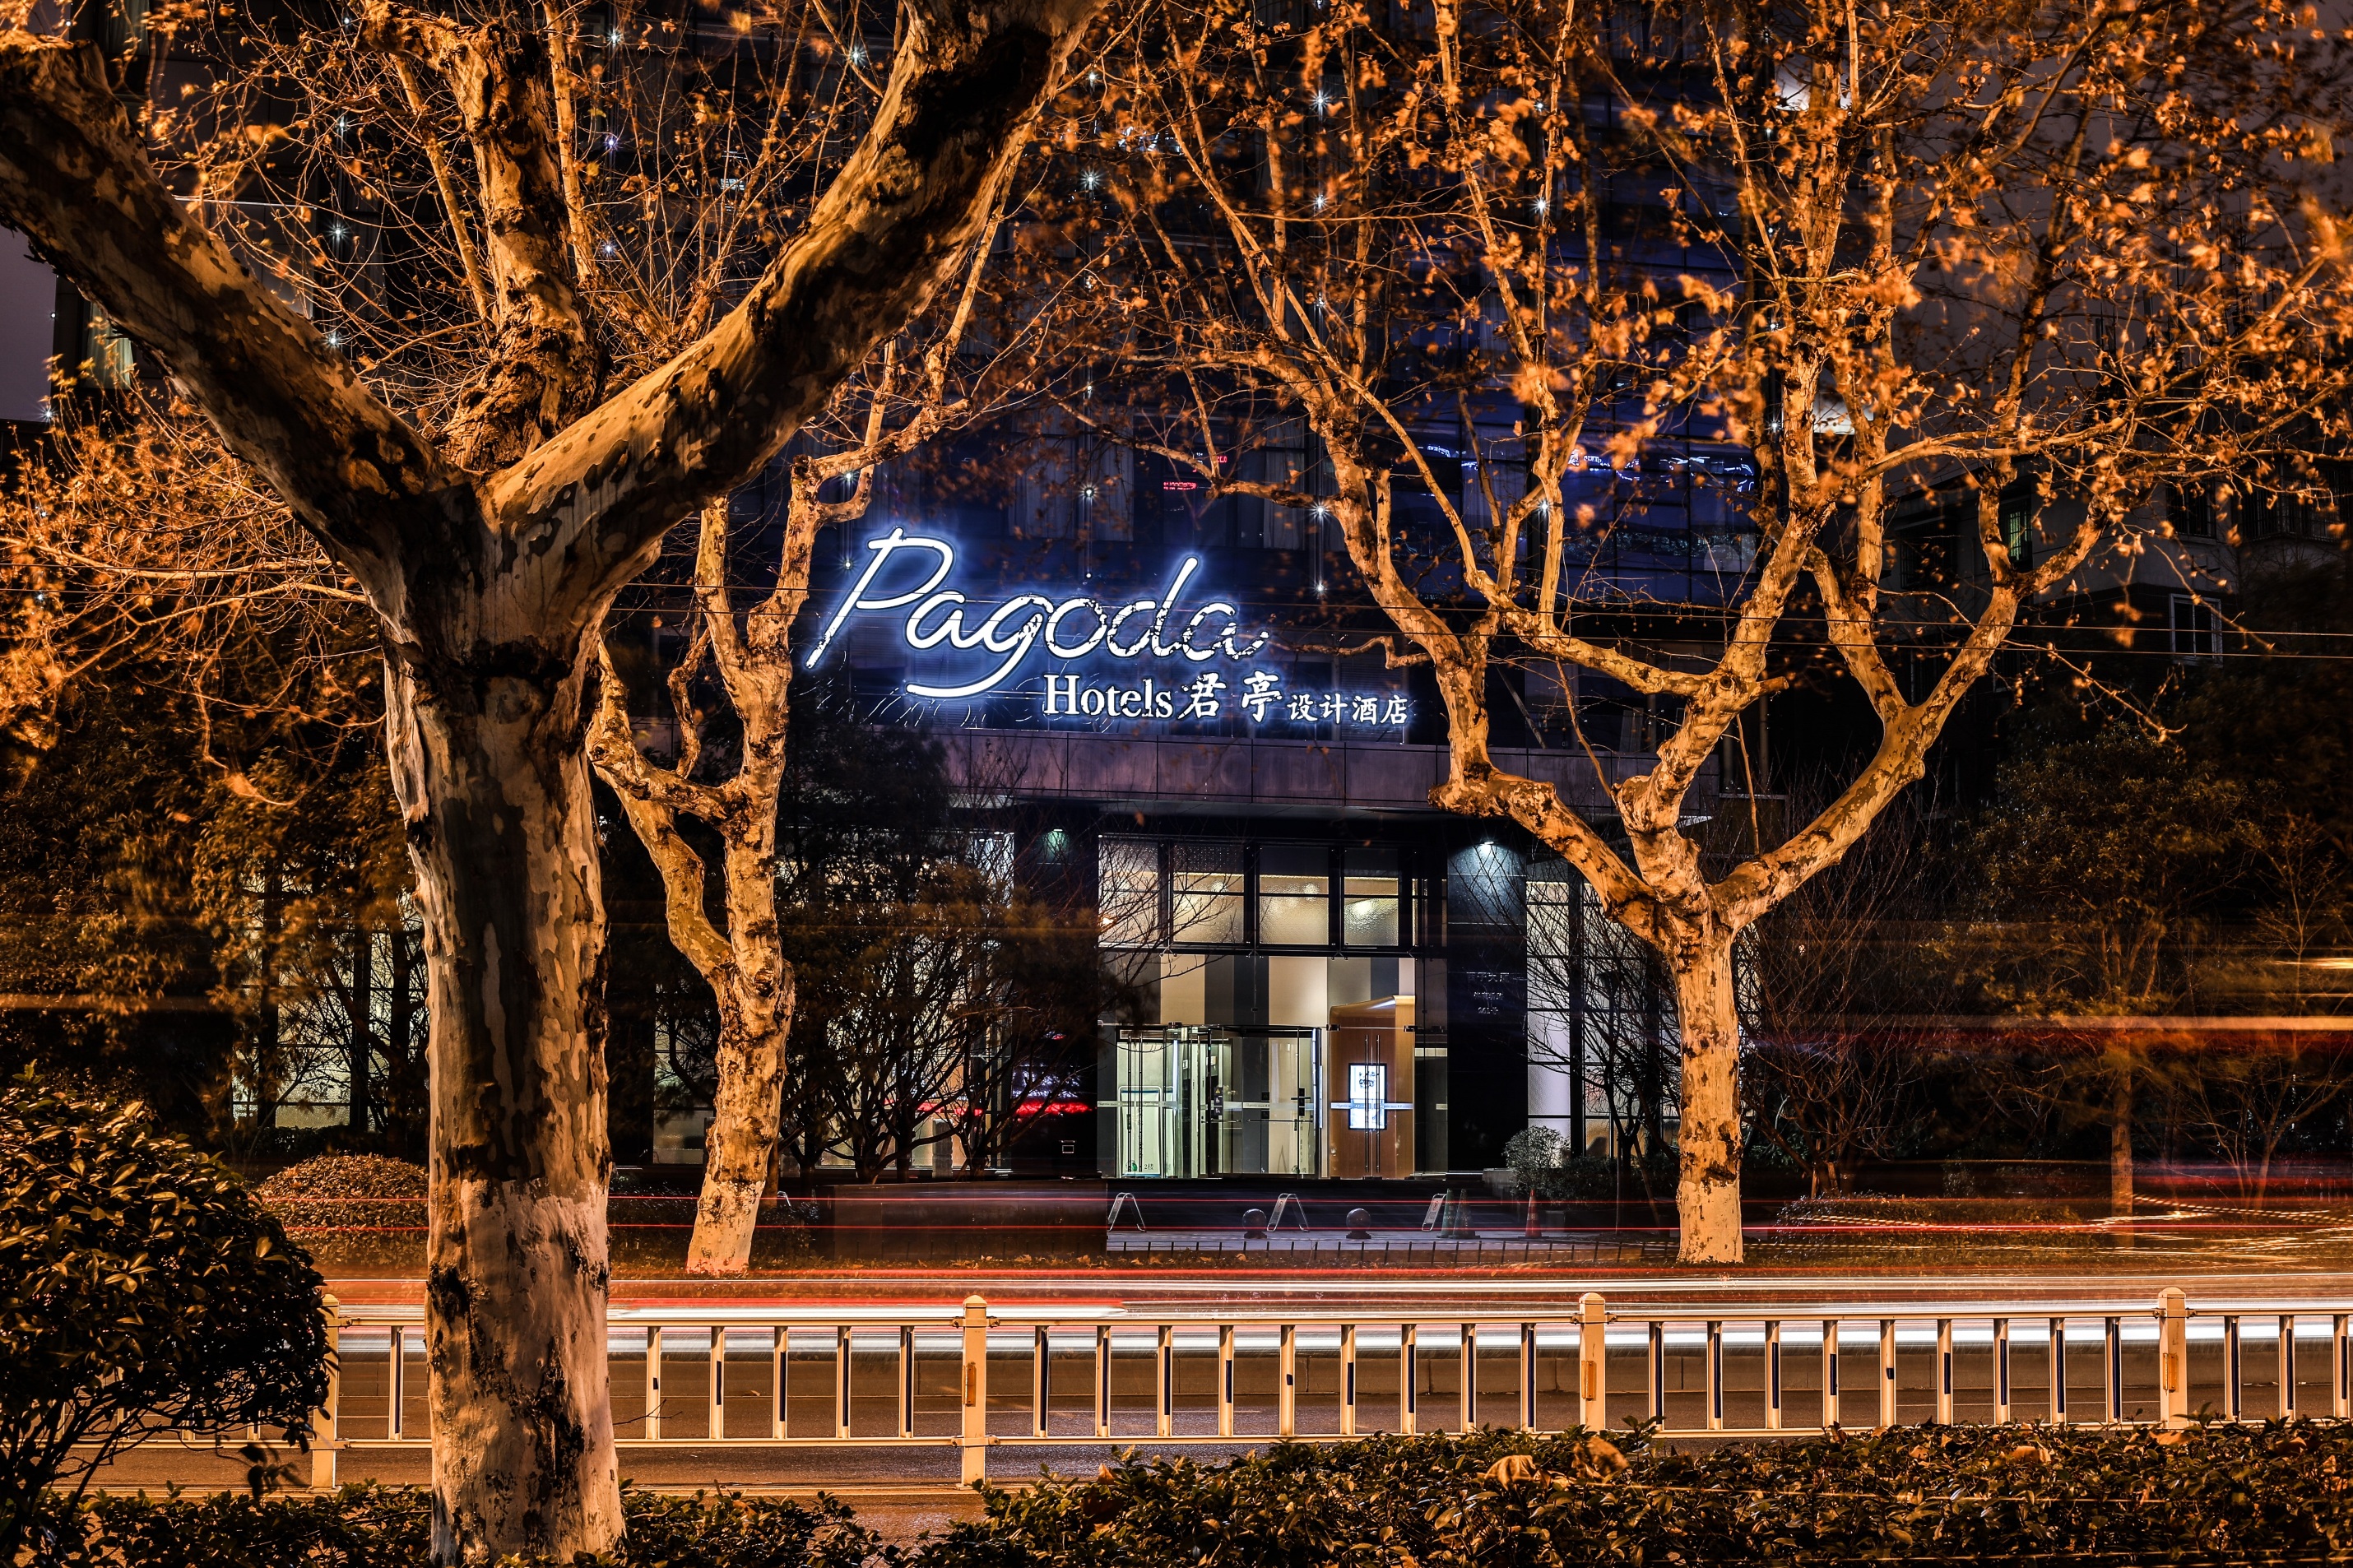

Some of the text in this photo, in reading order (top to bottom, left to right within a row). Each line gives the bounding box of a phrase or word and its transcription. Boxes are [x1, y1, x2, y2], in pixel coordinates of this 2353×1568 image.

[806, 527, 1269, 698] Pagoda
[1043, 674, 1173, 718] Hotels
[1287, 694, 1409, 725] 设计酒店
